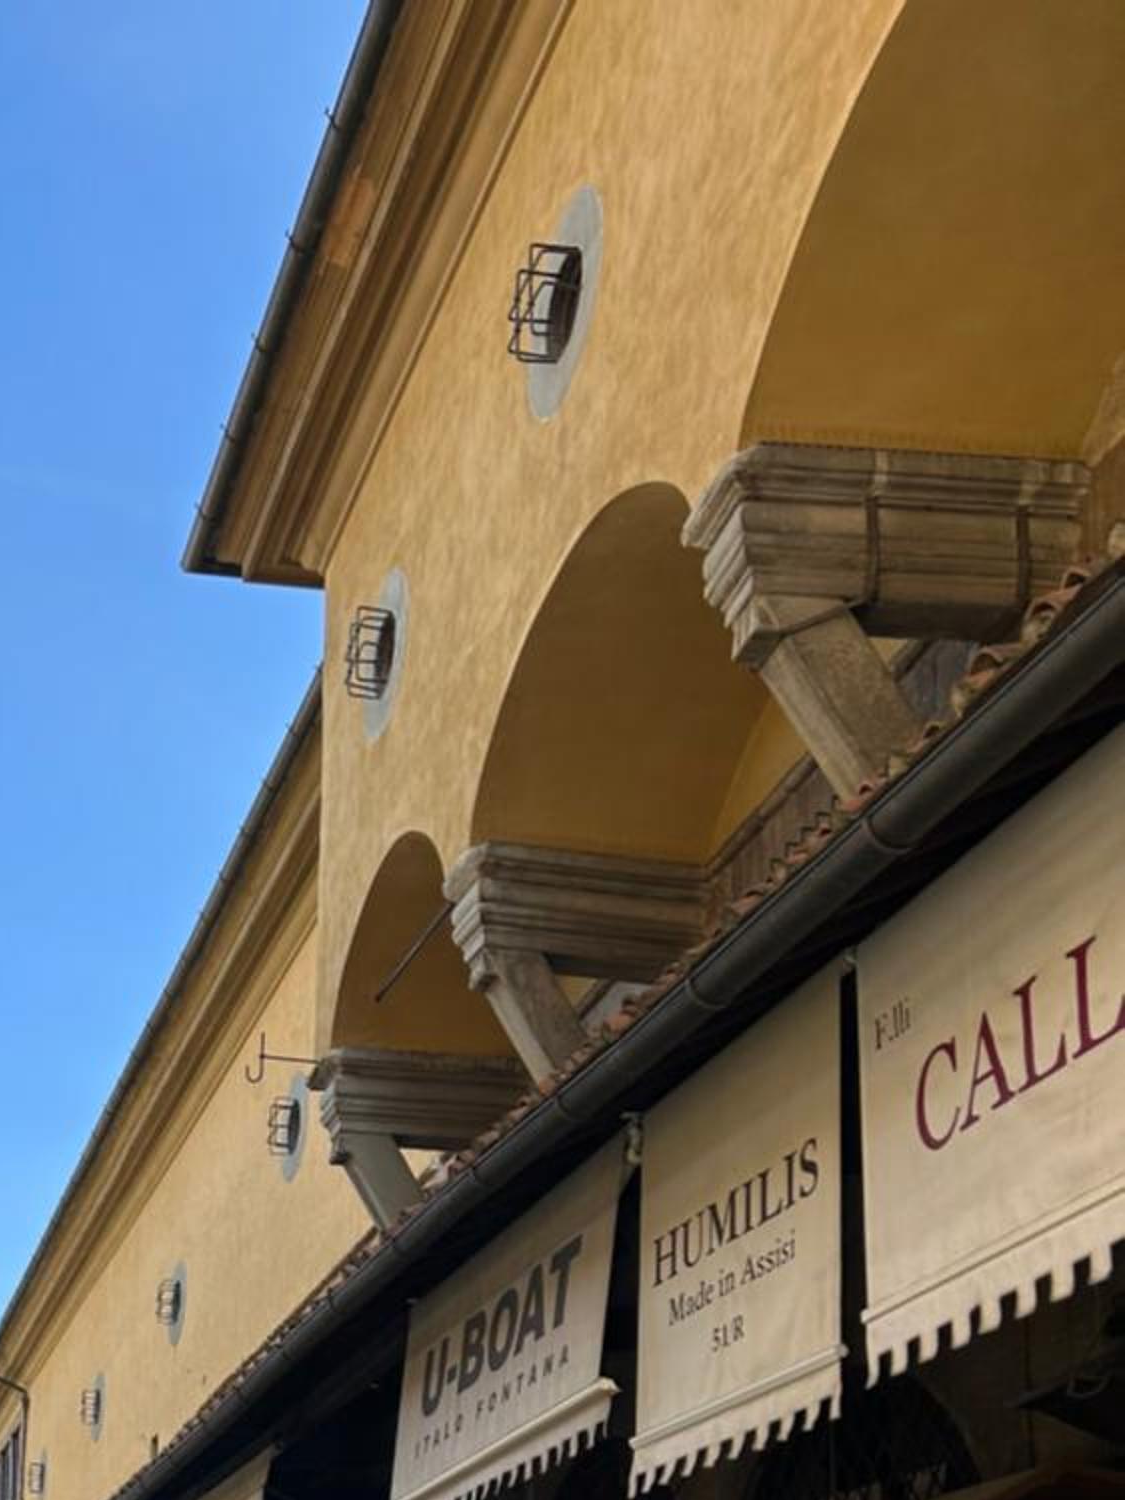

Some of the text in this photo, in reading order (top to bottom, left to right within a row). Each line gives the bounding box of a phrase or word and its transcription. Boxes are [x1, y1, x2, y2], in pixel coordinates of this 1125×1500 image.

[915, 934, 1125, 1151] CALL
[653, 1137, 819, 1288] HUMILIS
[668, 1228, 796, 1326] Made in Assisi
[421, 1234, 583, 1417] U-BOAT
[415, 1345, 569, 1459] ITALO FONTANA
